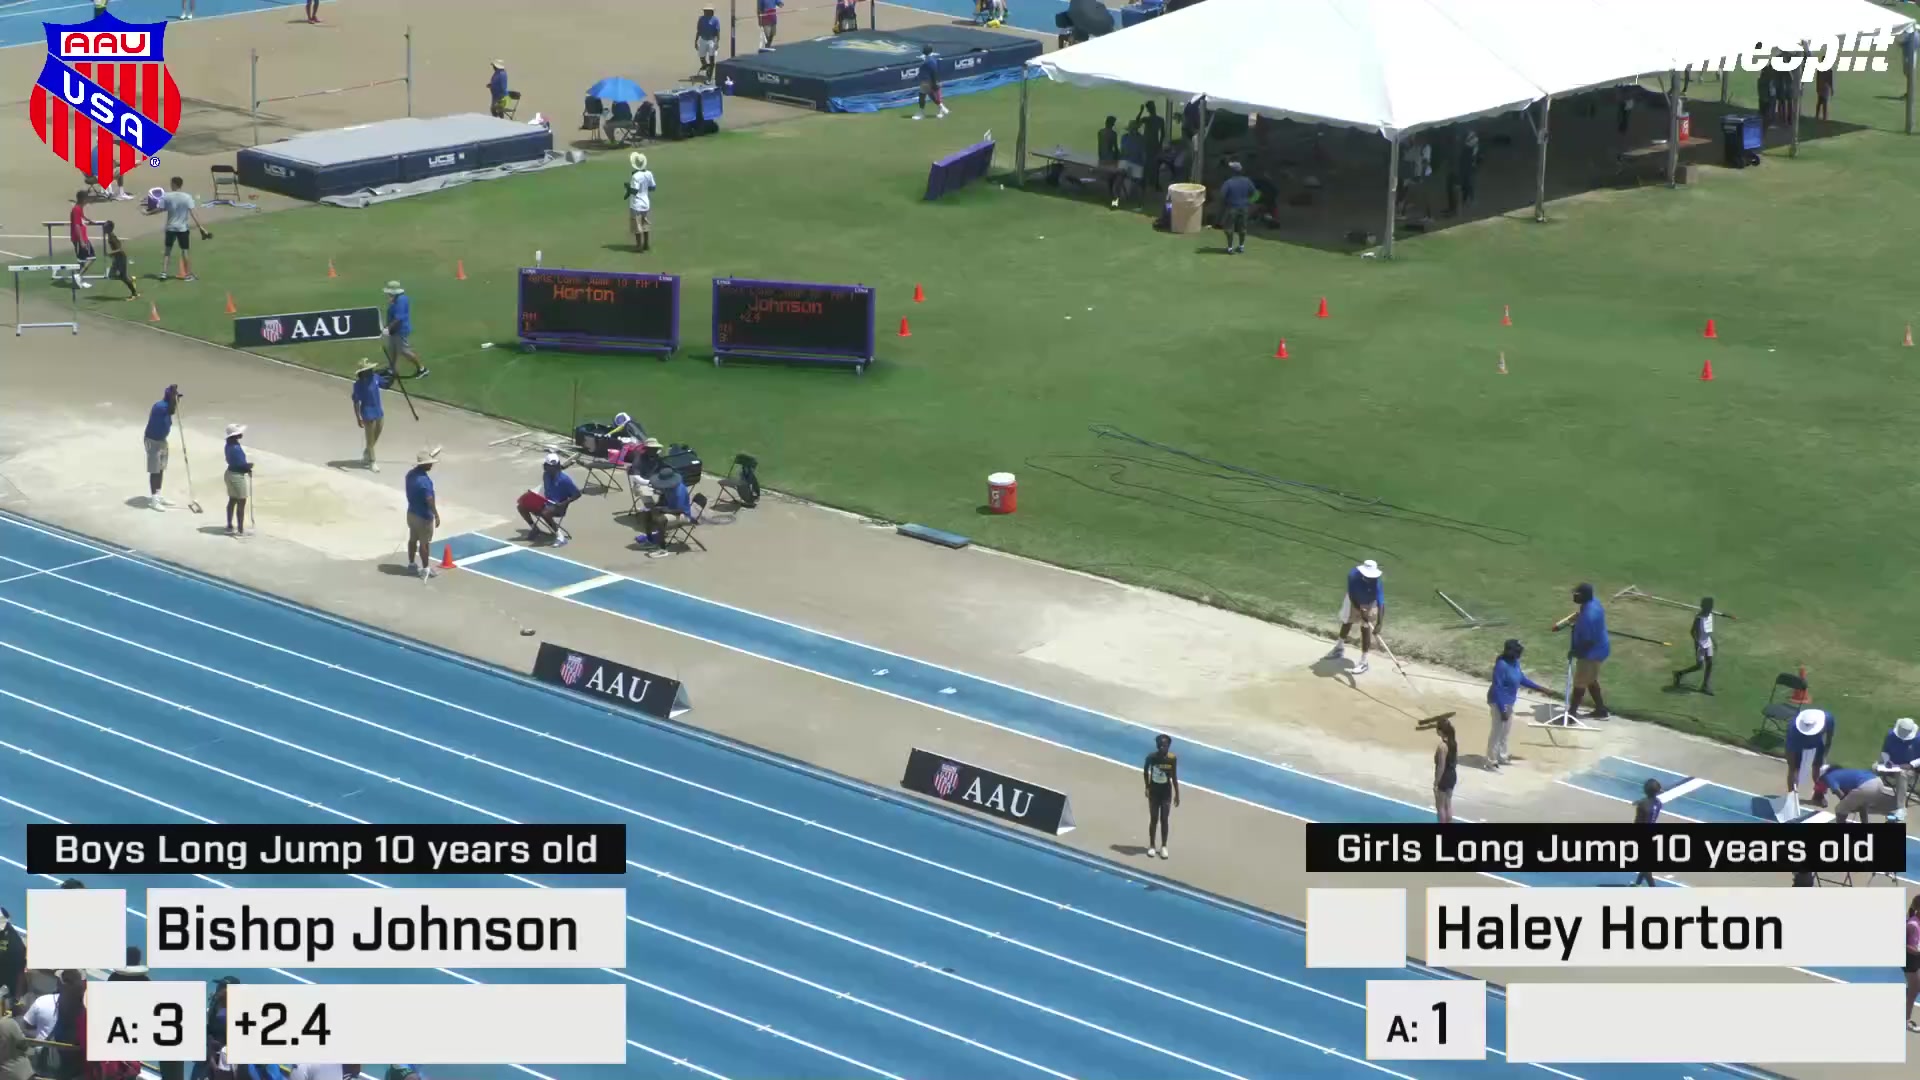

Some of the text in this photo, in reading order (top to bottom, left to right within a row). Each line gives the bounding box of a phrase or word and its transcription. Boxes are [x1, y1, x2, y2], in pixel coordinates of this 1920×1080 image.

[429, 152, 456, 166] UCS
[553, 284, 614, 302] Horton
[748, 296, 823, 314] Johnson
[291, 315, 352, 339] AAU
[585, 665, 652, 703] AAU
[962, 776, 1035, 818] AAU
